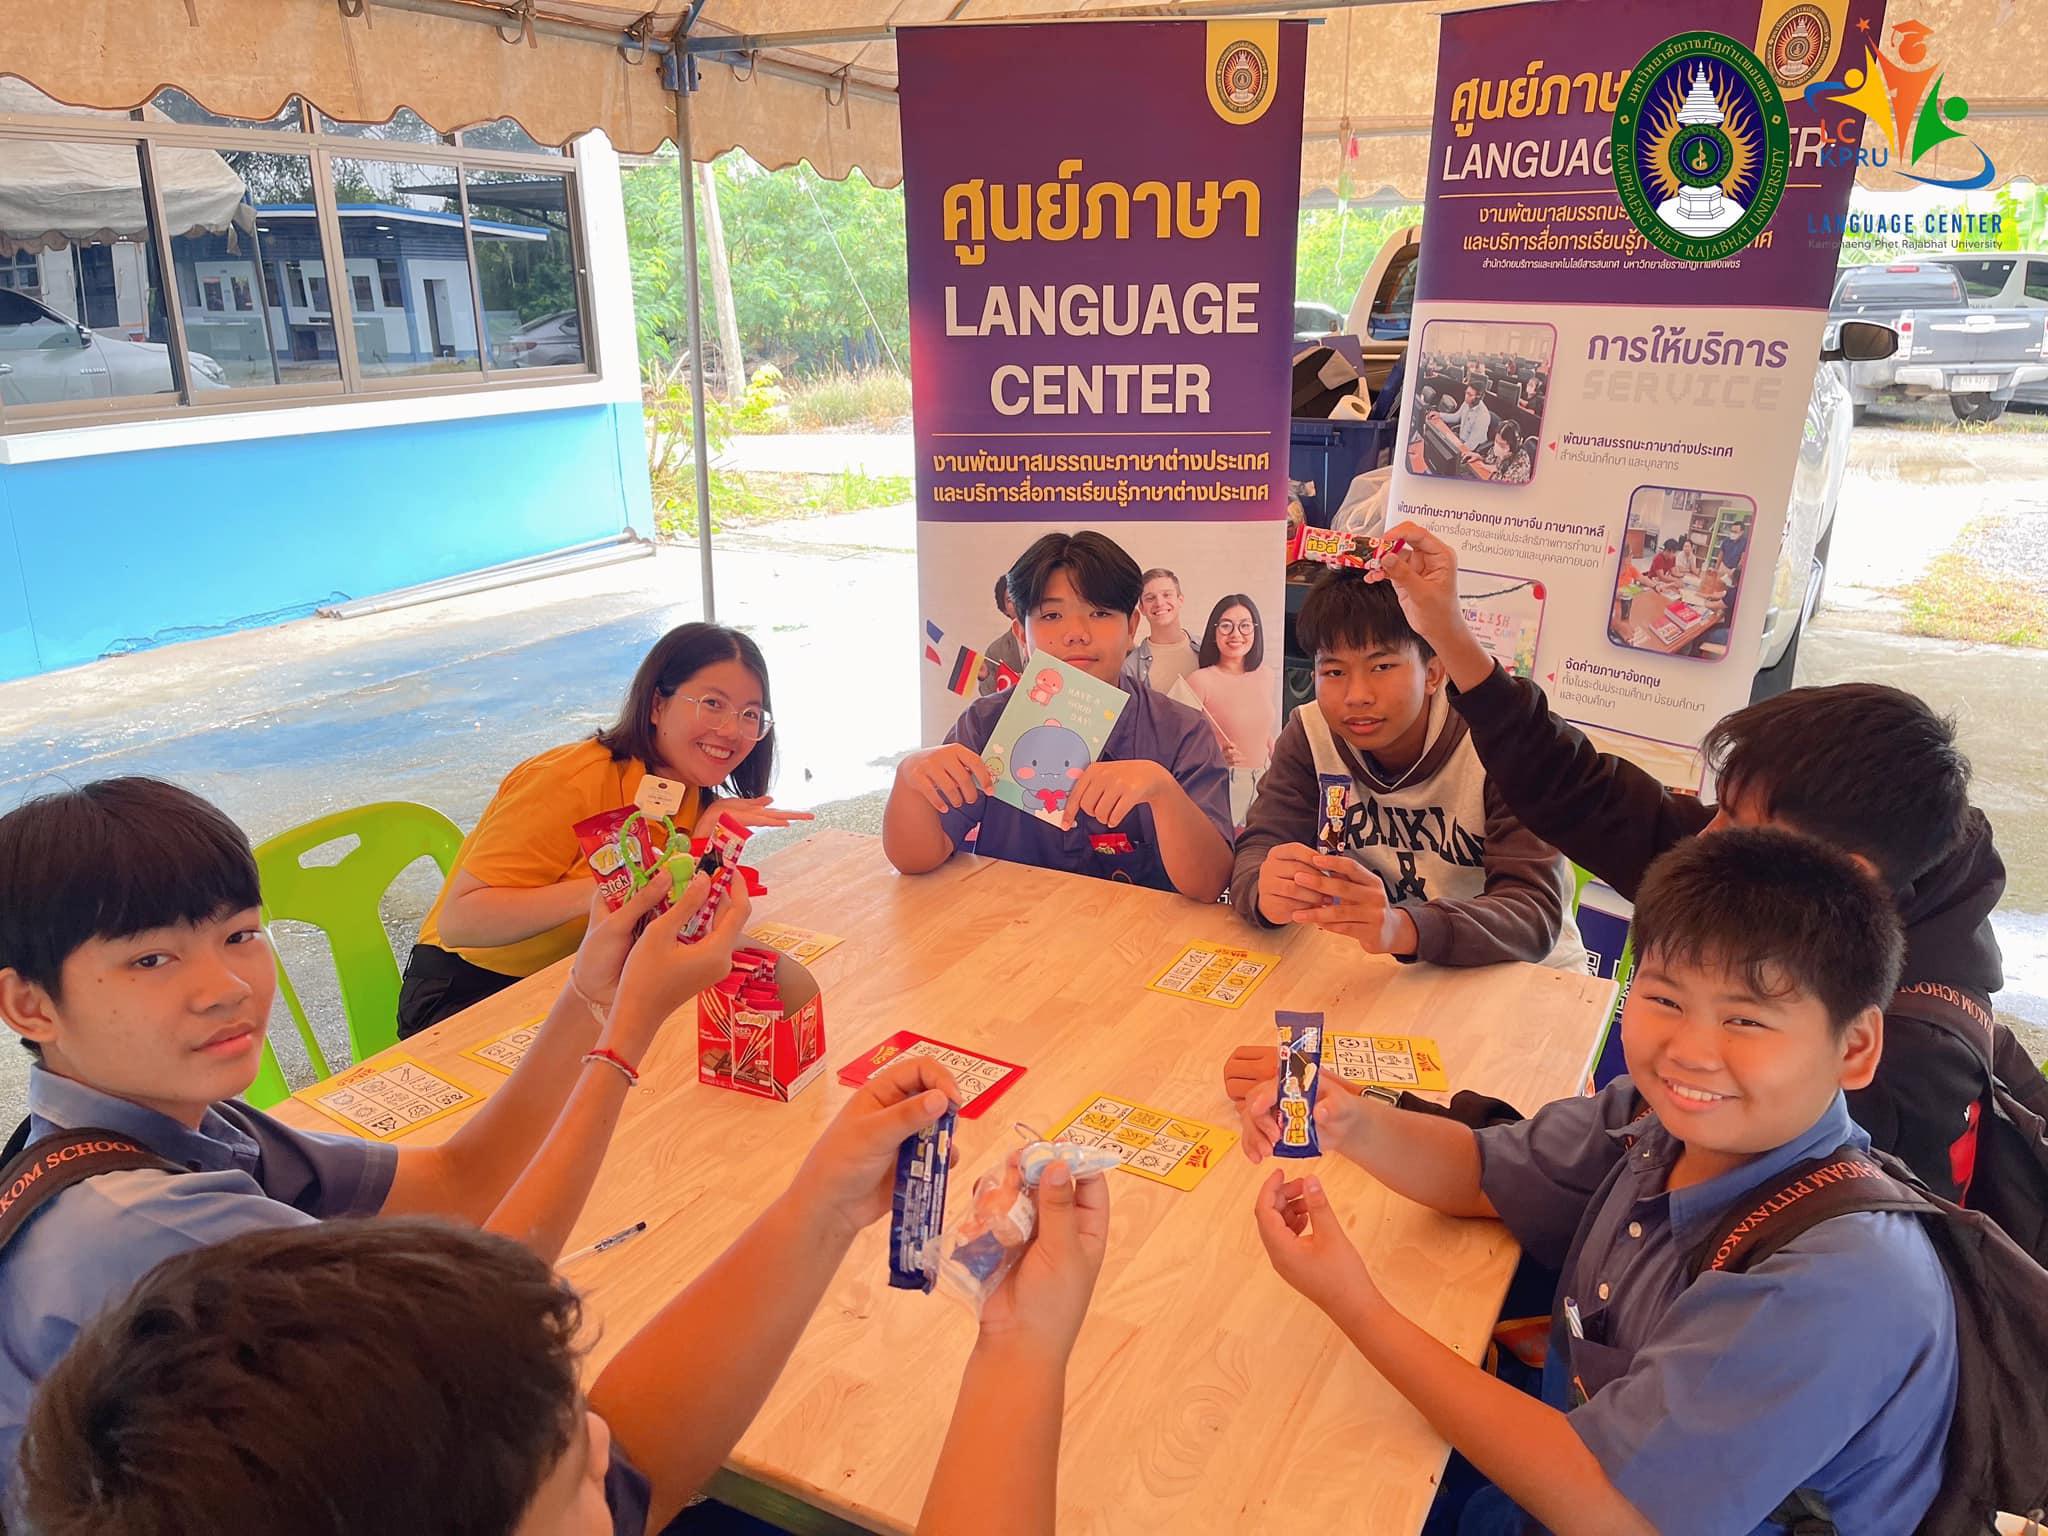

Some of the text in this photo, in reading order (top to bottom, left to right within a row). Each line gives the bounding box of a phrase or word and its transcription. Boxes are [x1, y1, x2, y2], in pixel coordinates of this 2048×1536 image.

[1450, 60, 1632, 137] ศูนย์ภาษ
[1443, 138, 1614, 181] LANGUAG
[943, 159, 1261, 265] ศูนย์ภาษา
[944, 282, 1260, 336] LANGUAGE
[1587, 325, 1789, 369] การให้บริการ
[990, 364, 1211, 416] CENTER
[1582, 369, 1786, 411] SERVICE
[933, 448, 1270, 473] งานพัฒนาสมรรถนะภาษาต่างประเทศ
[1563, 432, 1734, 458] พัฒนาสมรรถนะภาษาต่างประเทศ
[933, 476, 1270, 508] และบริการสื่อการเรียนรู้ภาษาต่างประเทศ
[1503, 514, 1543, 530] ภาษาจีน
[1544, 520, 1606, 537] ภาษาเกาหลี
[1565, 657, 1661, 689] จัดค่ายภาษาอังกฤษ
[1346, 797, 1485, 867] RANKLIN
